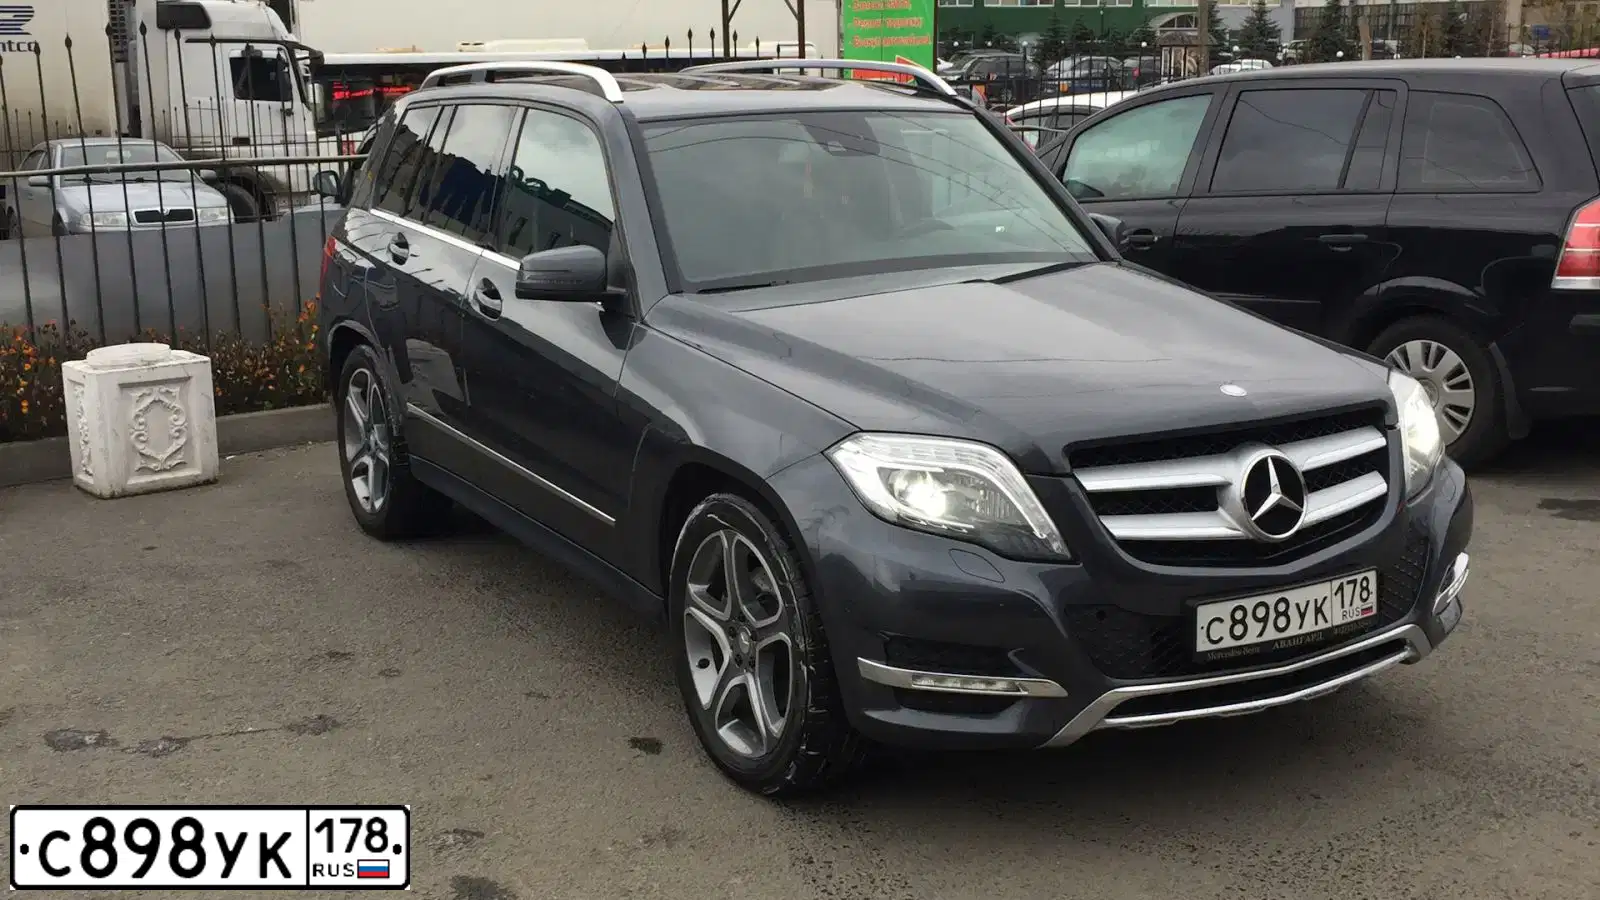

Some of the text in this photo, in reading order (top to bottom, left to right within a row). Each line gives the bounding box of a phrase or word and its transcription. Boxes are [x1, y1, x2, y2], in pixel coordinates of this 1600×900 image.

[1205, 575, 1371, 645] С898УК 178
[1342, 607, 1361, 621] RUS
